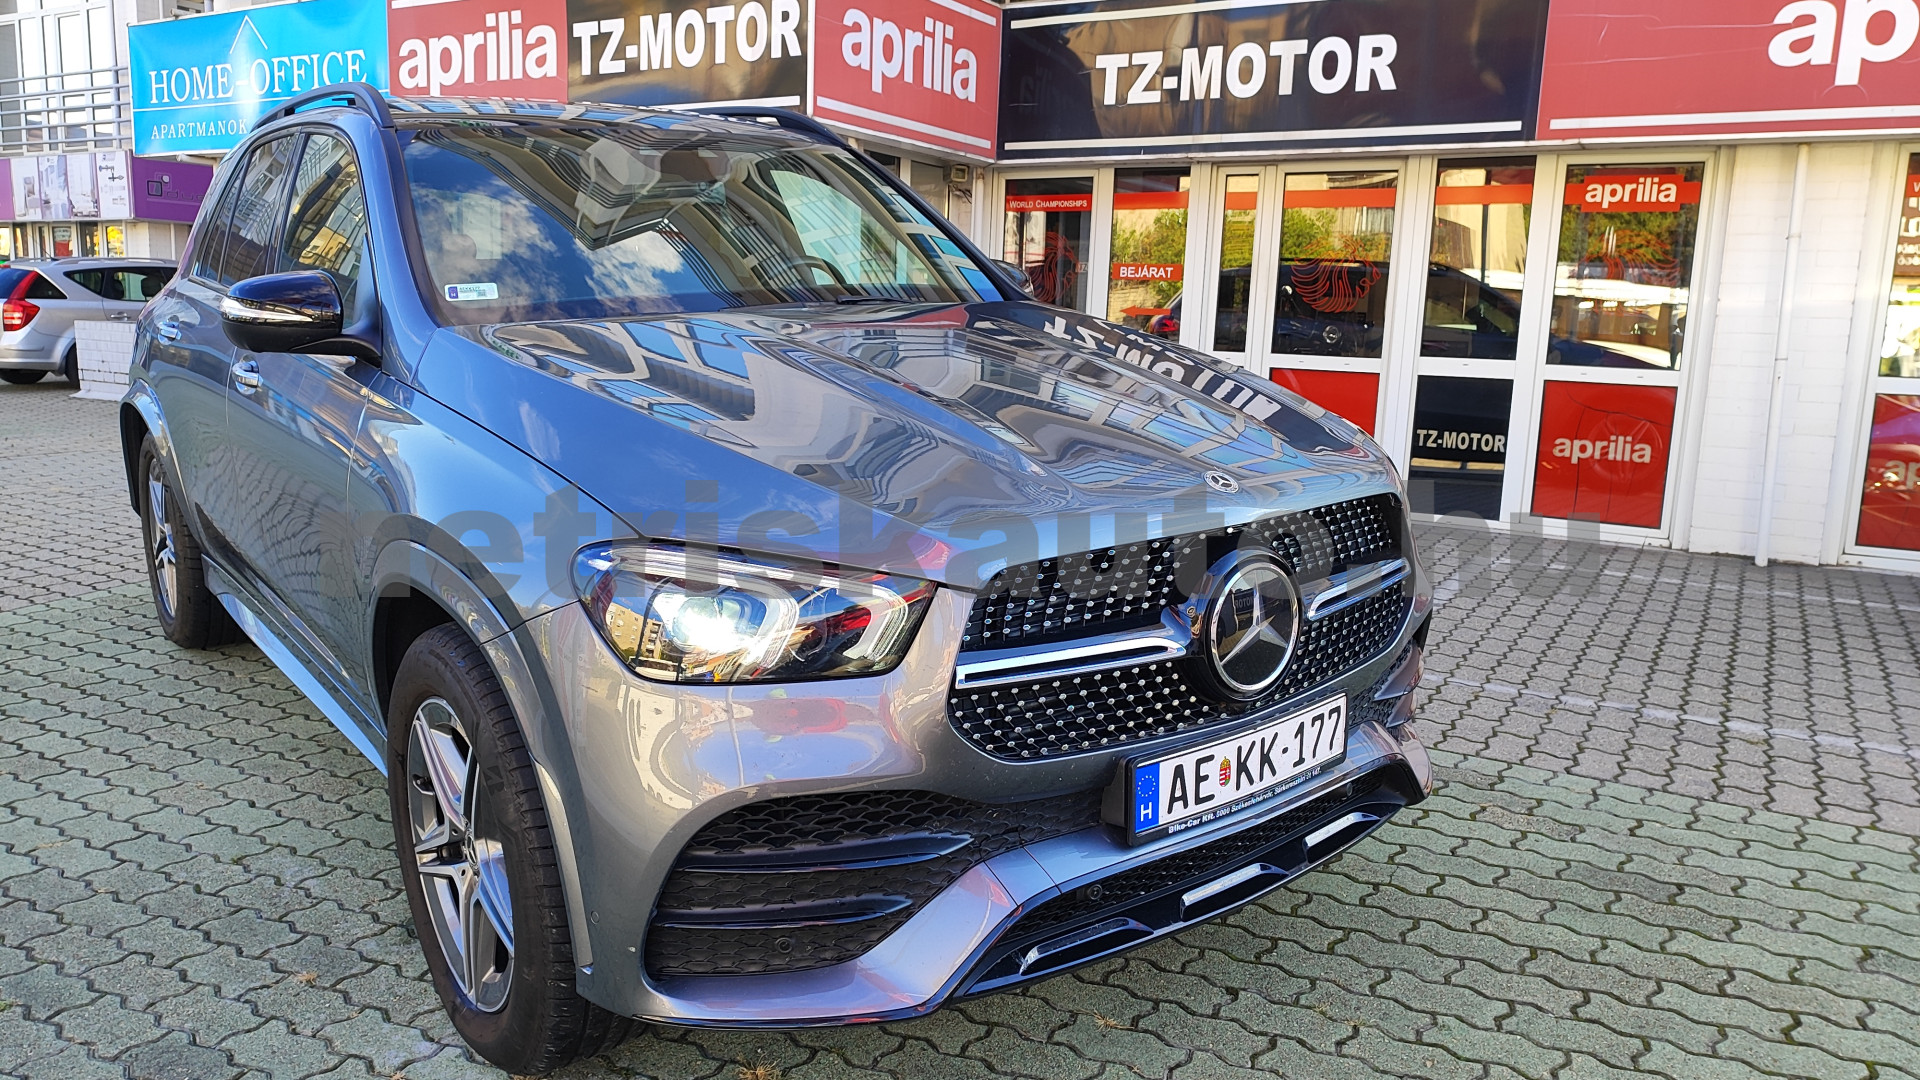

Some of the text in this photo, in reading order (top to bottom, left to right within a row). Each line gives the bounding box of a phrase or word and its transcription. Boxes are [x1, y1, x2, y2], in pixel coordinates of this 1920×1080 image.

[399, 11, 558, 97] aprilia
[572, 0, 802, 76] TZ-MOTOR
[841, 8, 979, 103] aprilia
[1095, 33, 1399, 106] TZ-MOTOR
[149, 49, 368, 104] HOME-OFFICE
[151, 118, 248, 140] APARTMANOK
[1035, 199, 1088, 208] CHAMPIONSHIPS
[1584, 177, 1678, 209] aprilia
[1119, 263, 1174, 280] BEJÁRAT
[1416, 428, 1506, 453] TZ-MOTOR
[1552, 435, 1652, 465] aprilia
[1167, 705, 1342, 815] AE KK-177
[1140, 801, 1153, 823] H
